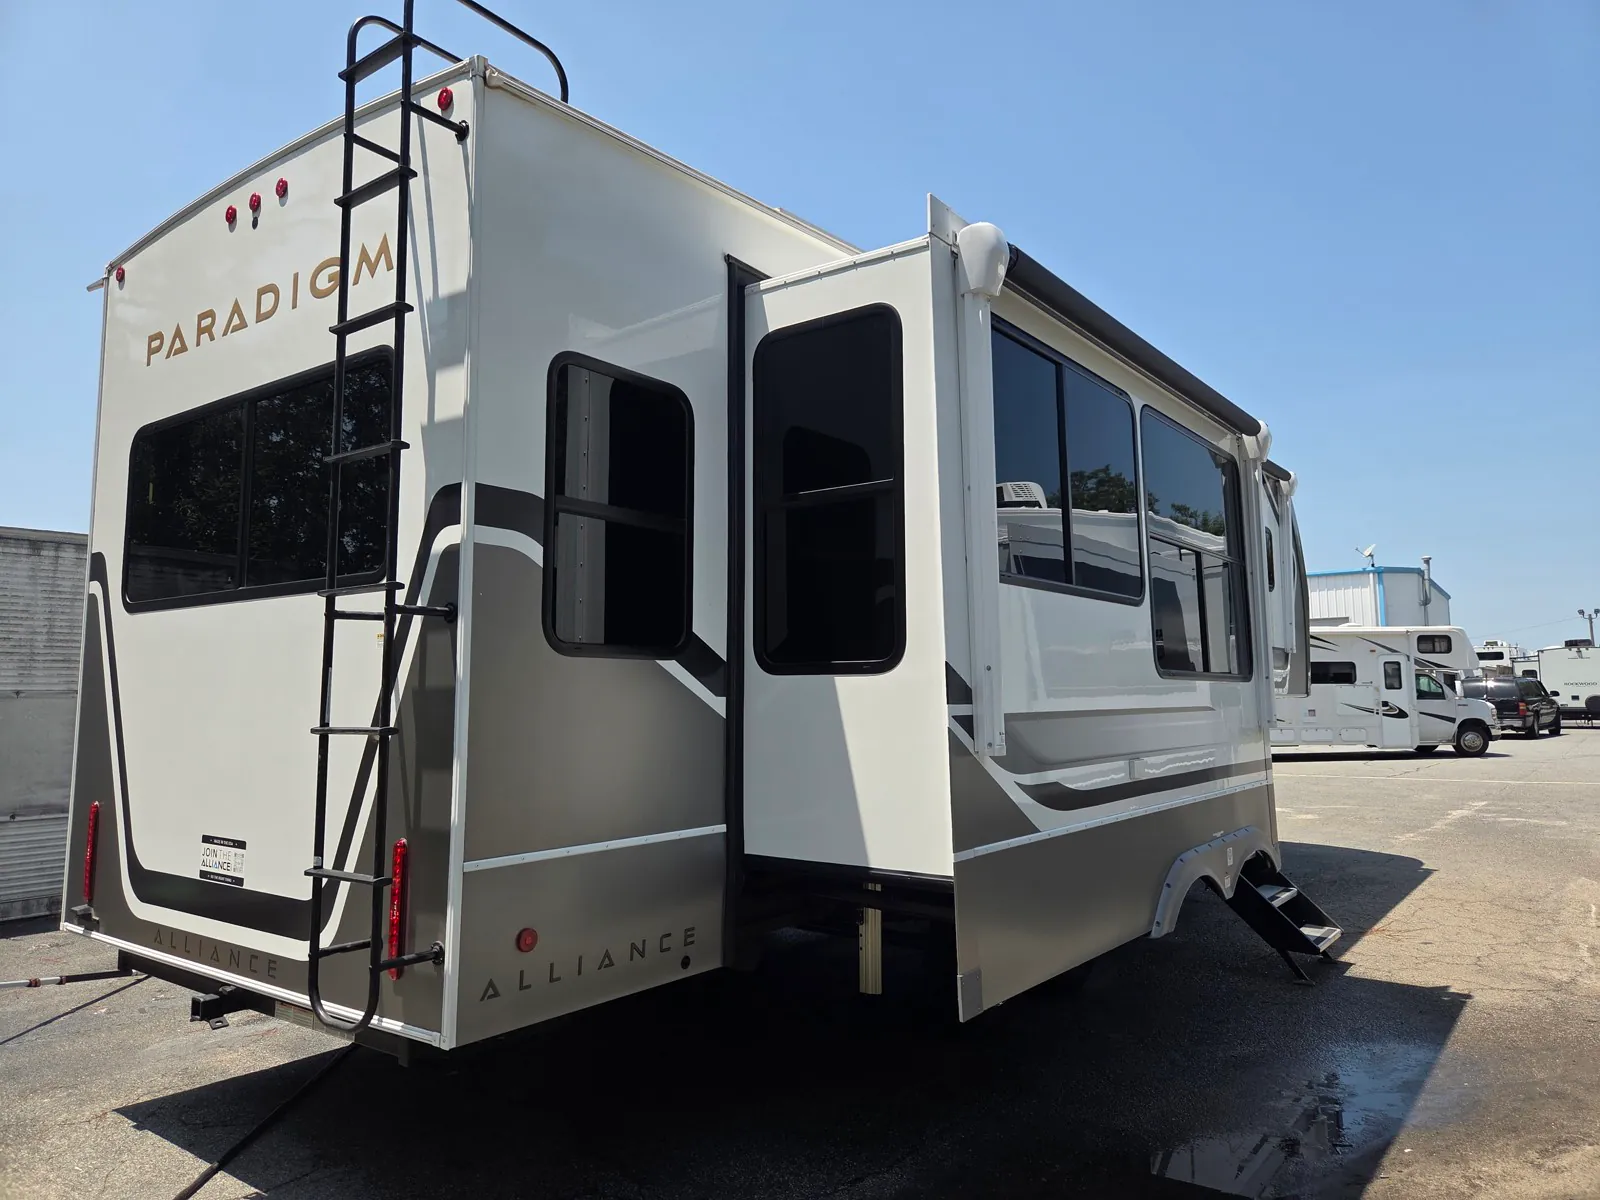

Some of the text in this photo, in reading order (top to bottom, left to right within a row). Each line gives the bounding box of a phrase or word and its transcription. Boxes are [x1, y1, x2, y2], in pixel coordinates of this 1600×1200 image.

[146, 232, 394, 367] PARADIGM
[201, 858, 231, 871] ALLIANCE
[202, 847, 231, 861] JOIN THE
[154, 928, 279, 979] ALLIANCE
[479, 926, 696, 1002] ALLIANCE
